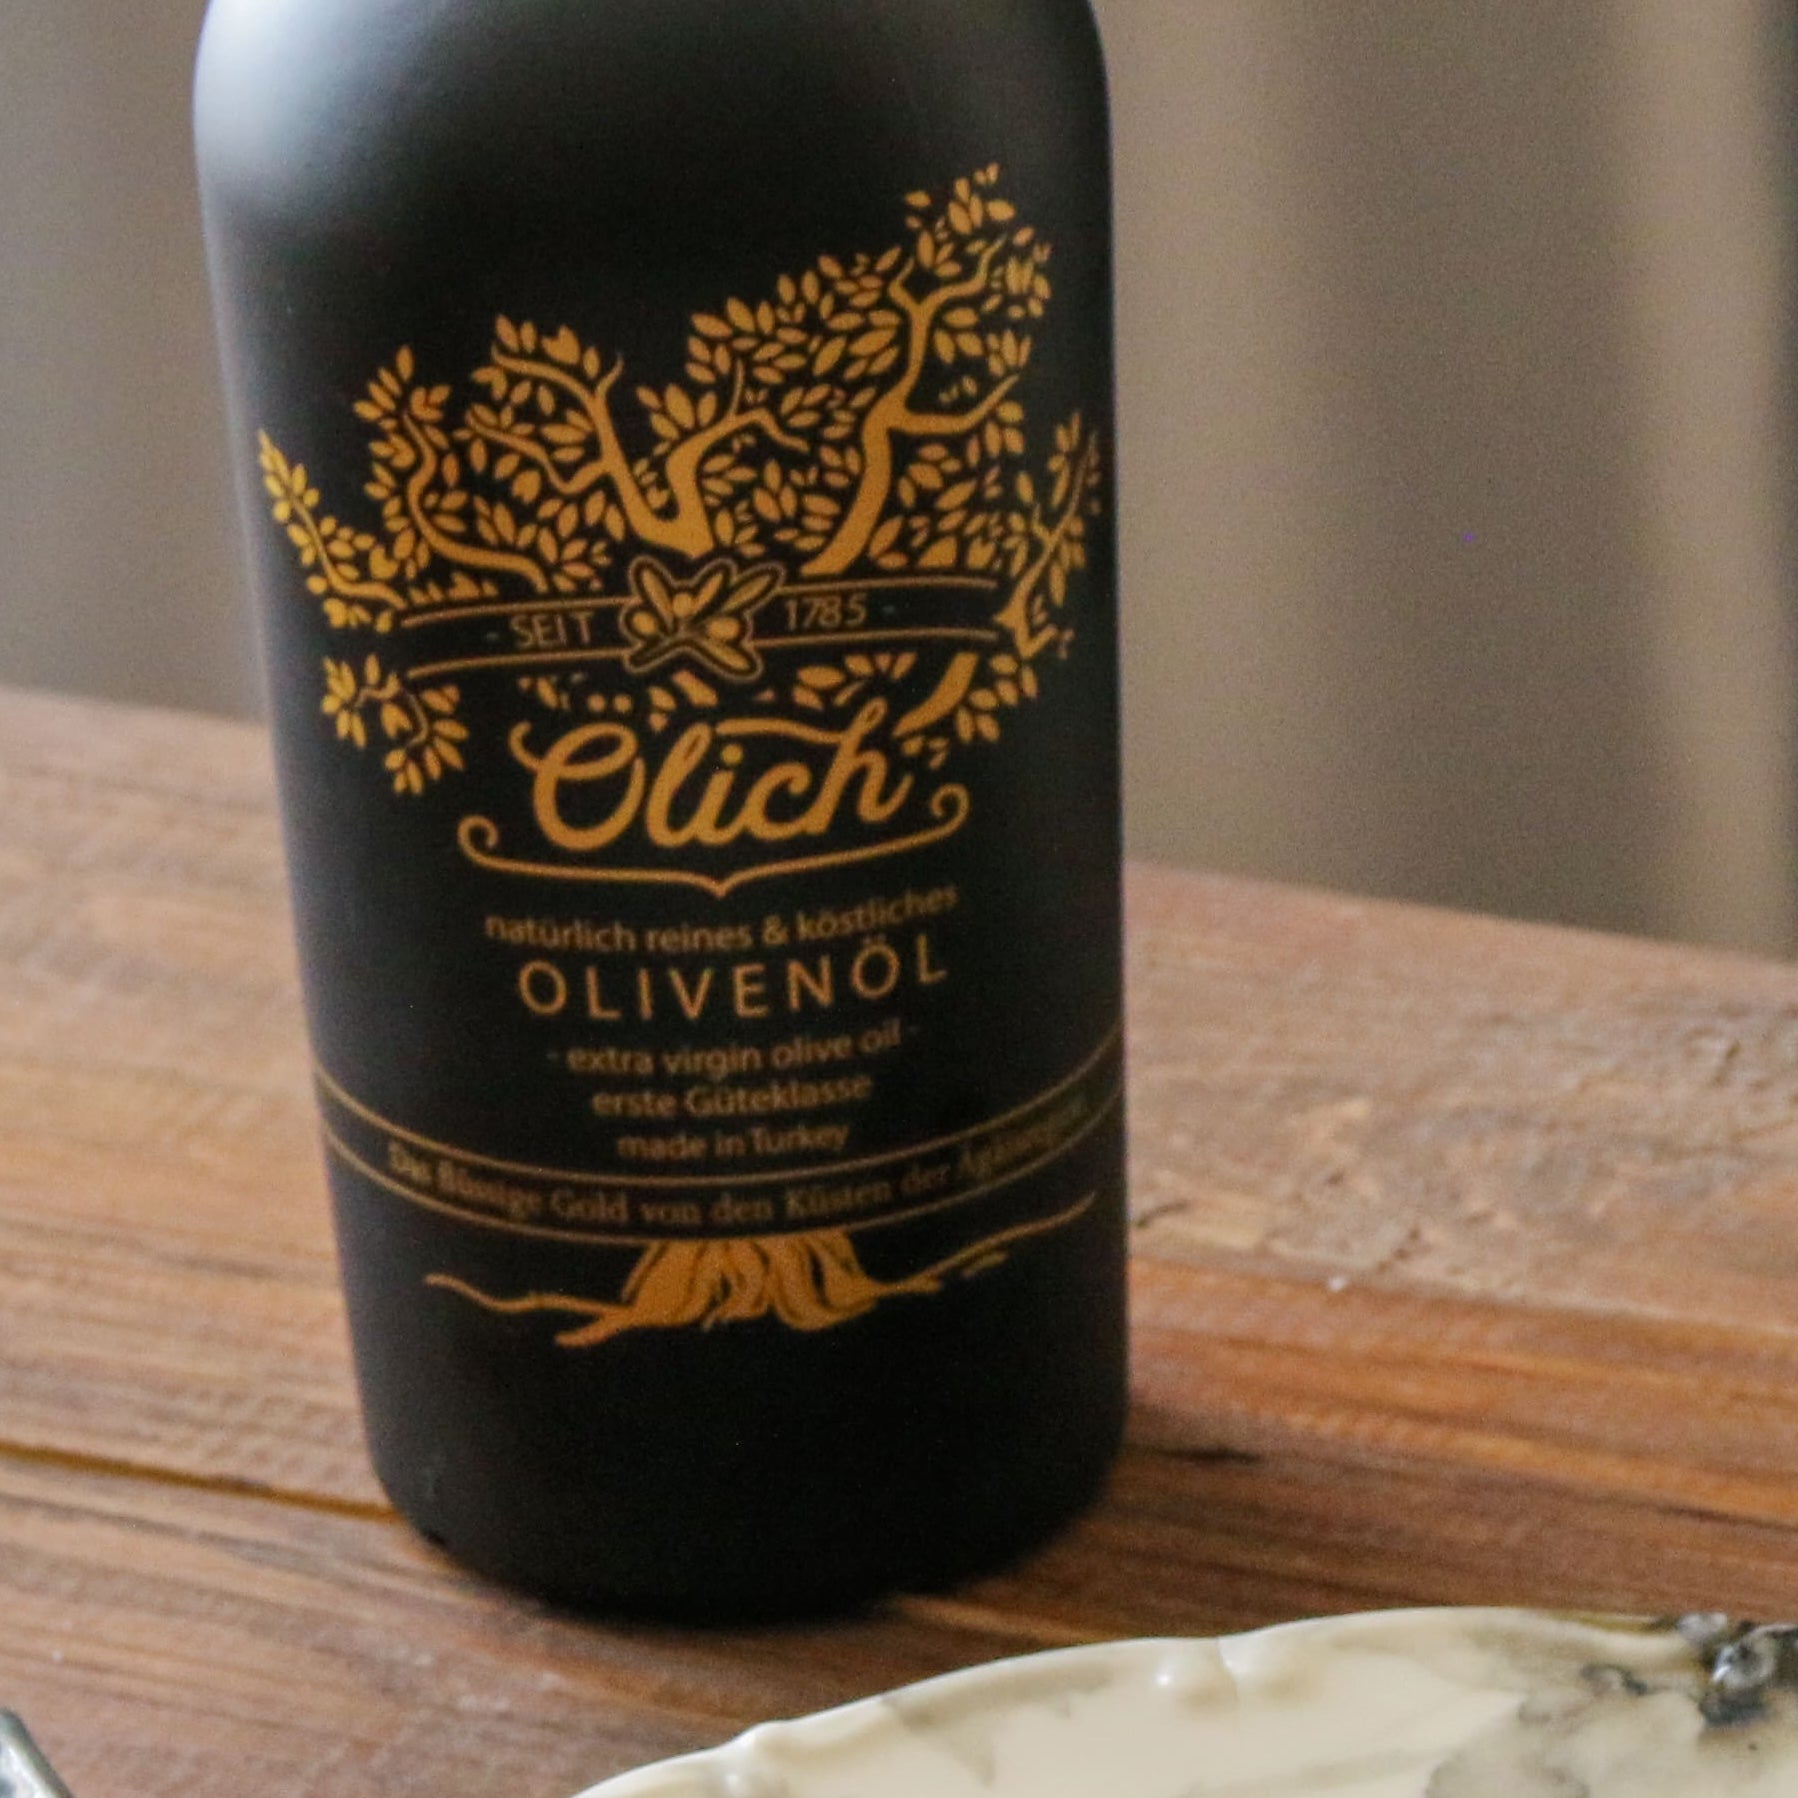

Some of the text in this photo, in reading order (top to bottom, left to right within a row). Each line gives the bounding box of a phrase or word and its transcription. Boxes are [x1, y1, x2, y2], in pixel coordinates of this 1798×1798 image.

[510, 594, 868, 651] SEIT 1785
[484, 882, 958, 951] natürlich reines & köstliches
[517, 932, 948, 1020] OLIVENÖL
[566, 1017, 900, 1083] extra virgin olive oil
[592, 1073, 871, 1118] erste Güteklasse
[616, 1122, 849, 1161] made in Turkey
[548, 1189, 631, 1224] Gold
[639, 1201, 703, 1227] von
[710, 1192, 775, 1225] den
